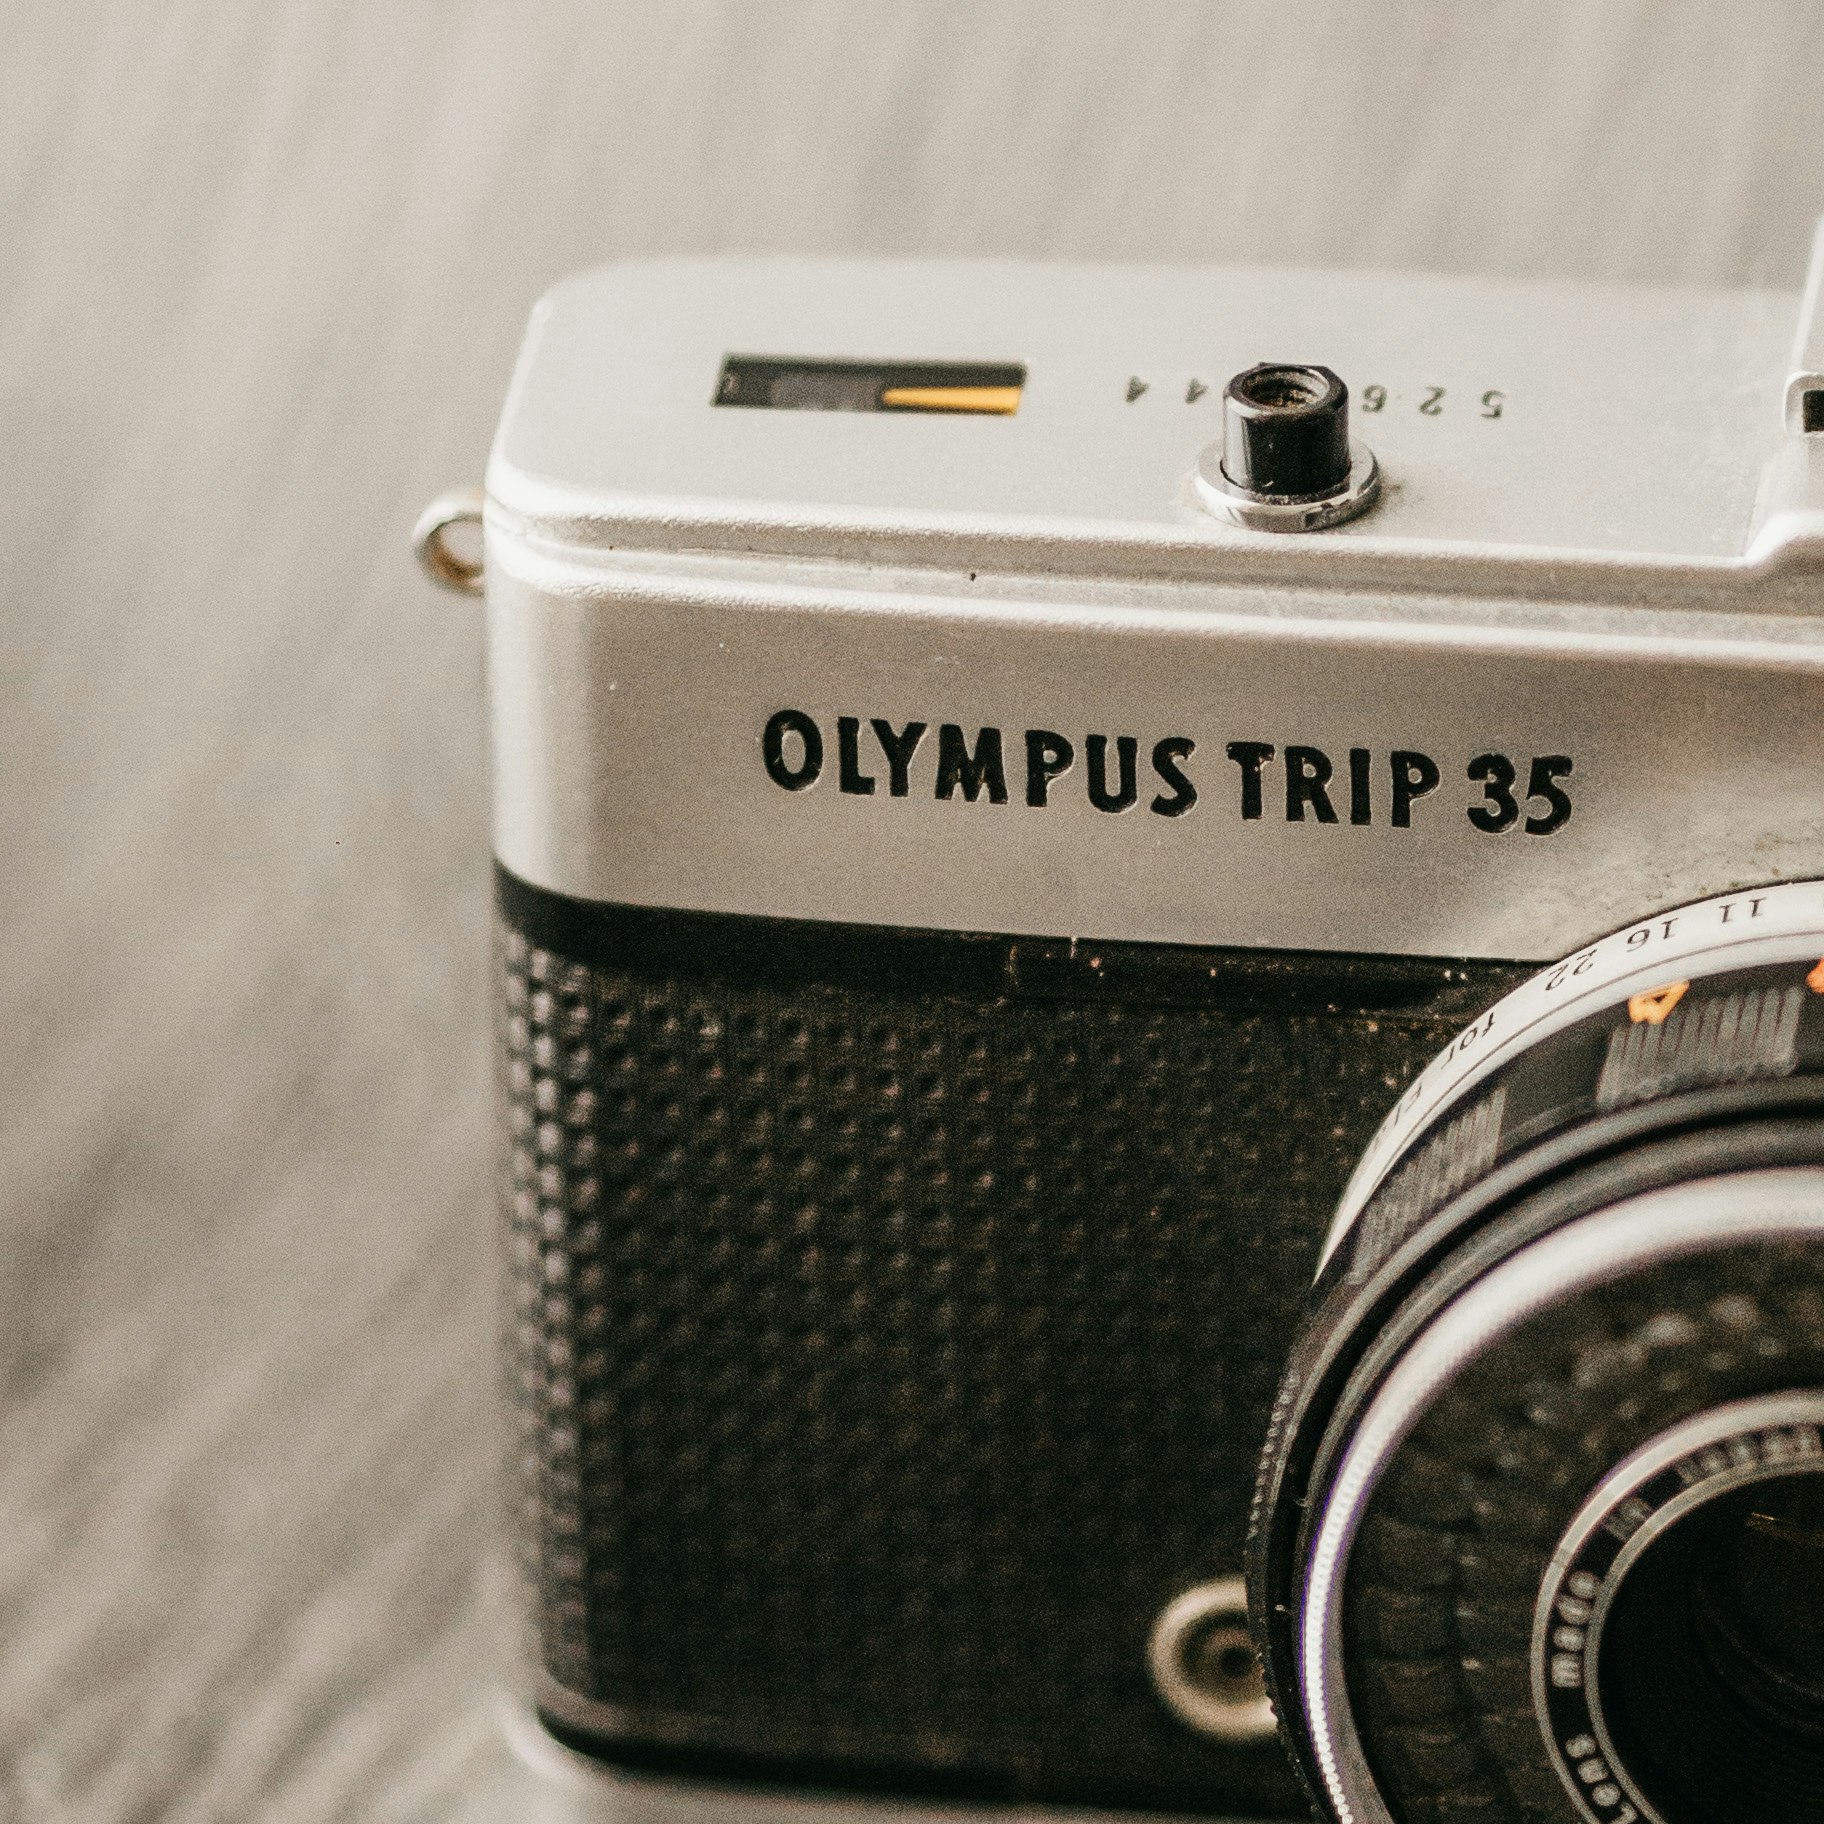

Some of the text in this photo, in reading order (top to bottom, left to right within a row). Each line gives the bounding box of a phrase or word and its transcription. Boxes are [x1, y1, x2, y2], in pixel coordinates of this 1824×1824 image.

[762, 709, 1574, 836] OLYMPUS TRIP 35
[1719, 897, 1768, 925] 11
[1626, 917, 1681, 953] 16
[1544, 948, 1599, 992] 22
